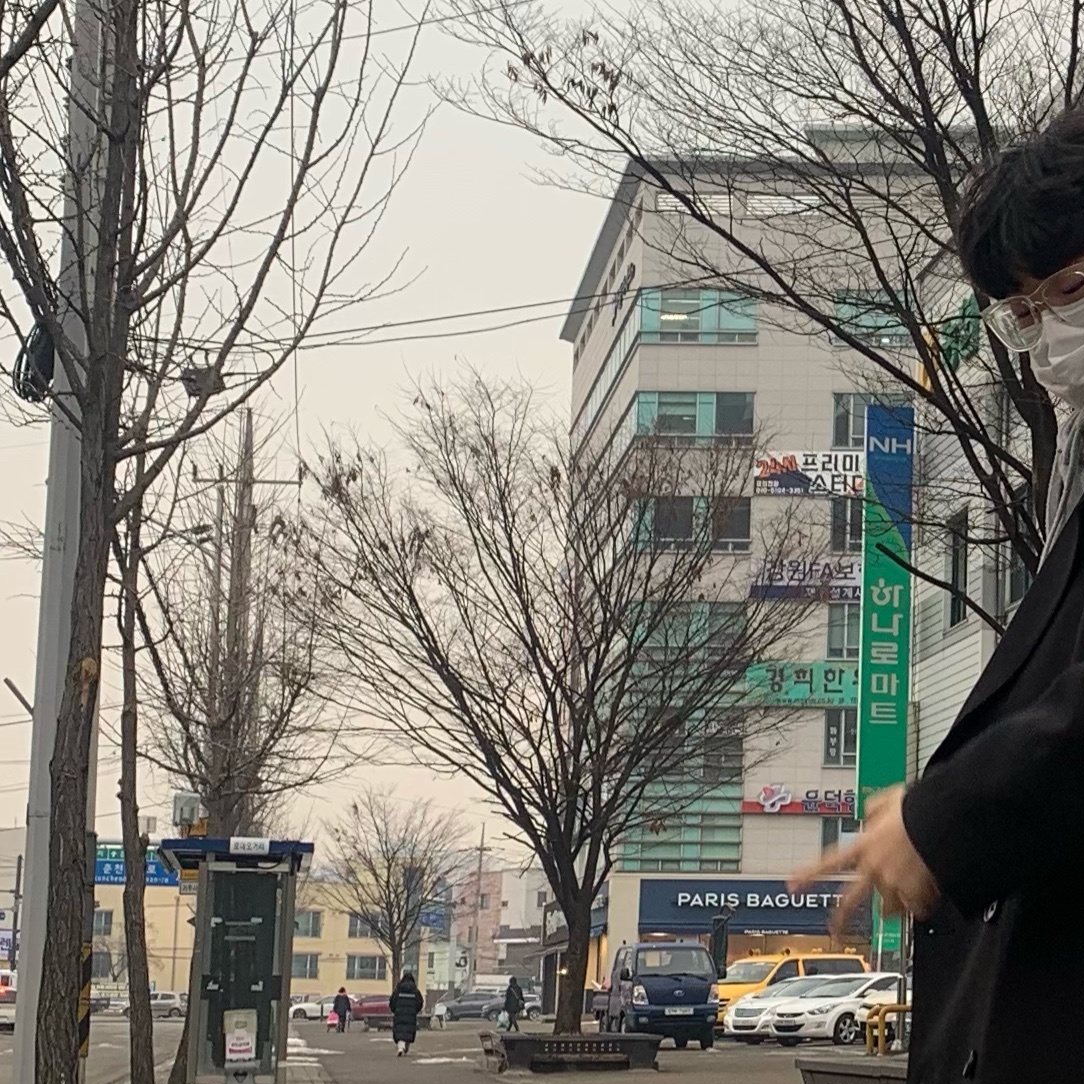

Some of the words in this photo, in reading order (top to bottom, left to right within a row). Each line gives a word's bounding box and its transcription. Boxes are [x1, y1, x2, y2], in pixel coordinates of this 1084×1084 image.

[868, 436, 912, 455] NH
[869, 577, 904, 725] 하나로마트
[677, 892, 740, 907] PARIS
